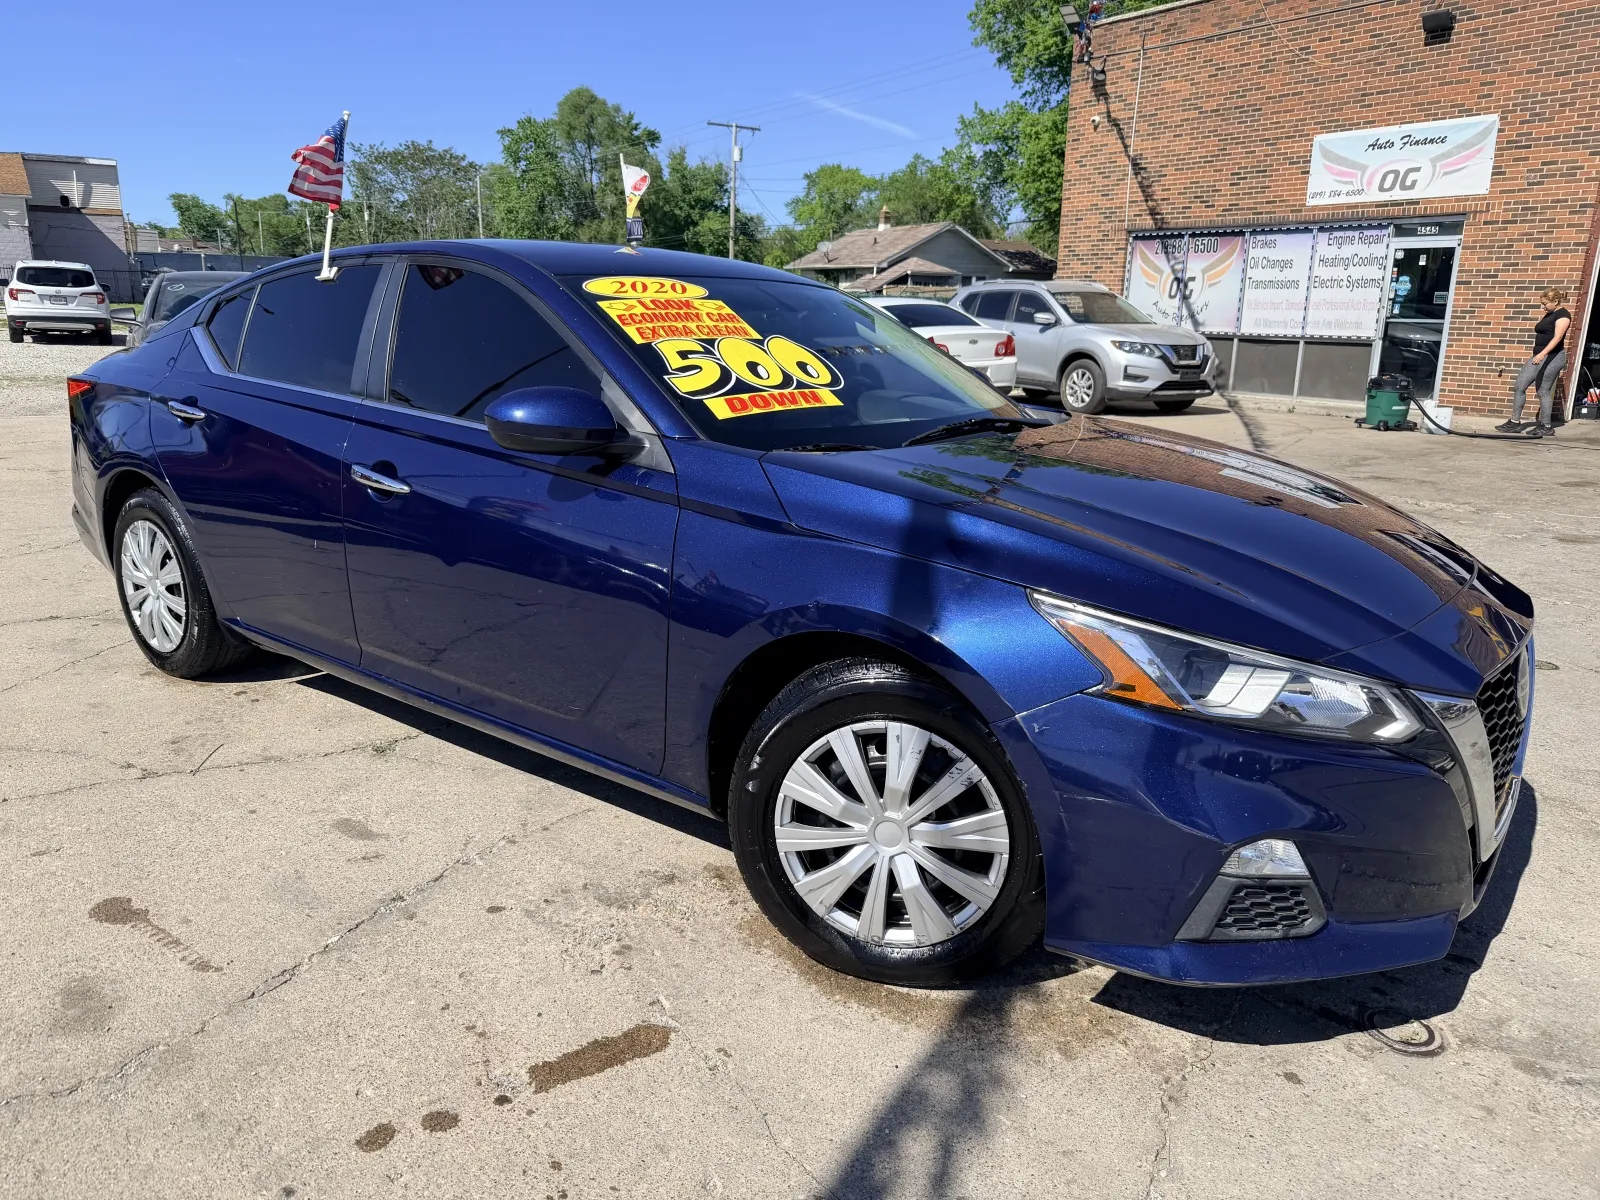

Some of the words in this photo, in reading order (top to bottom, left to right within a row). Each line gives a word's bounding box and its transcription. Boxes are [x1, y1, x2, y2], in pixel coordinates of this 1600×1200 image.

[1365, 137, 1395, 152] Auto
[1399, 134, 1448, 150] Finance
[1377, 166, 1422, 193] OG
[1417, 226, 1439, 234] 4545
[1251, 237, 1277, 249] Brakes
[1327, 233, 1355, 249] Engine
[1357, 231, 1386, 247] Repair
[1249, 257, 1260, 269] Oil
[1261, 257, 1293, 272] Changes
[1318, 254, 1384, 270] Heating/Cooling
[611, 280, 688, 295] 2020
[1168, 276, 1196, 300] OG
[1247, 277, 1300, 290] Transmissions
[1312, 276, 1344, 289] Electric
[1345, 275, 1381, 292] Systems
[636, 298, 700, 312] LOOK
[1152, 300, 1170, 319] Auto
[616, 312, 703, 327] ECONOMY
[705, 312, 744, 325] CAR
[635, 325, 696, 341] EXTRA
[696, 323, 751, 338] CLEAN
[653, 335, 844, 399] 500
[723, 390, 826, 415] DOWN
